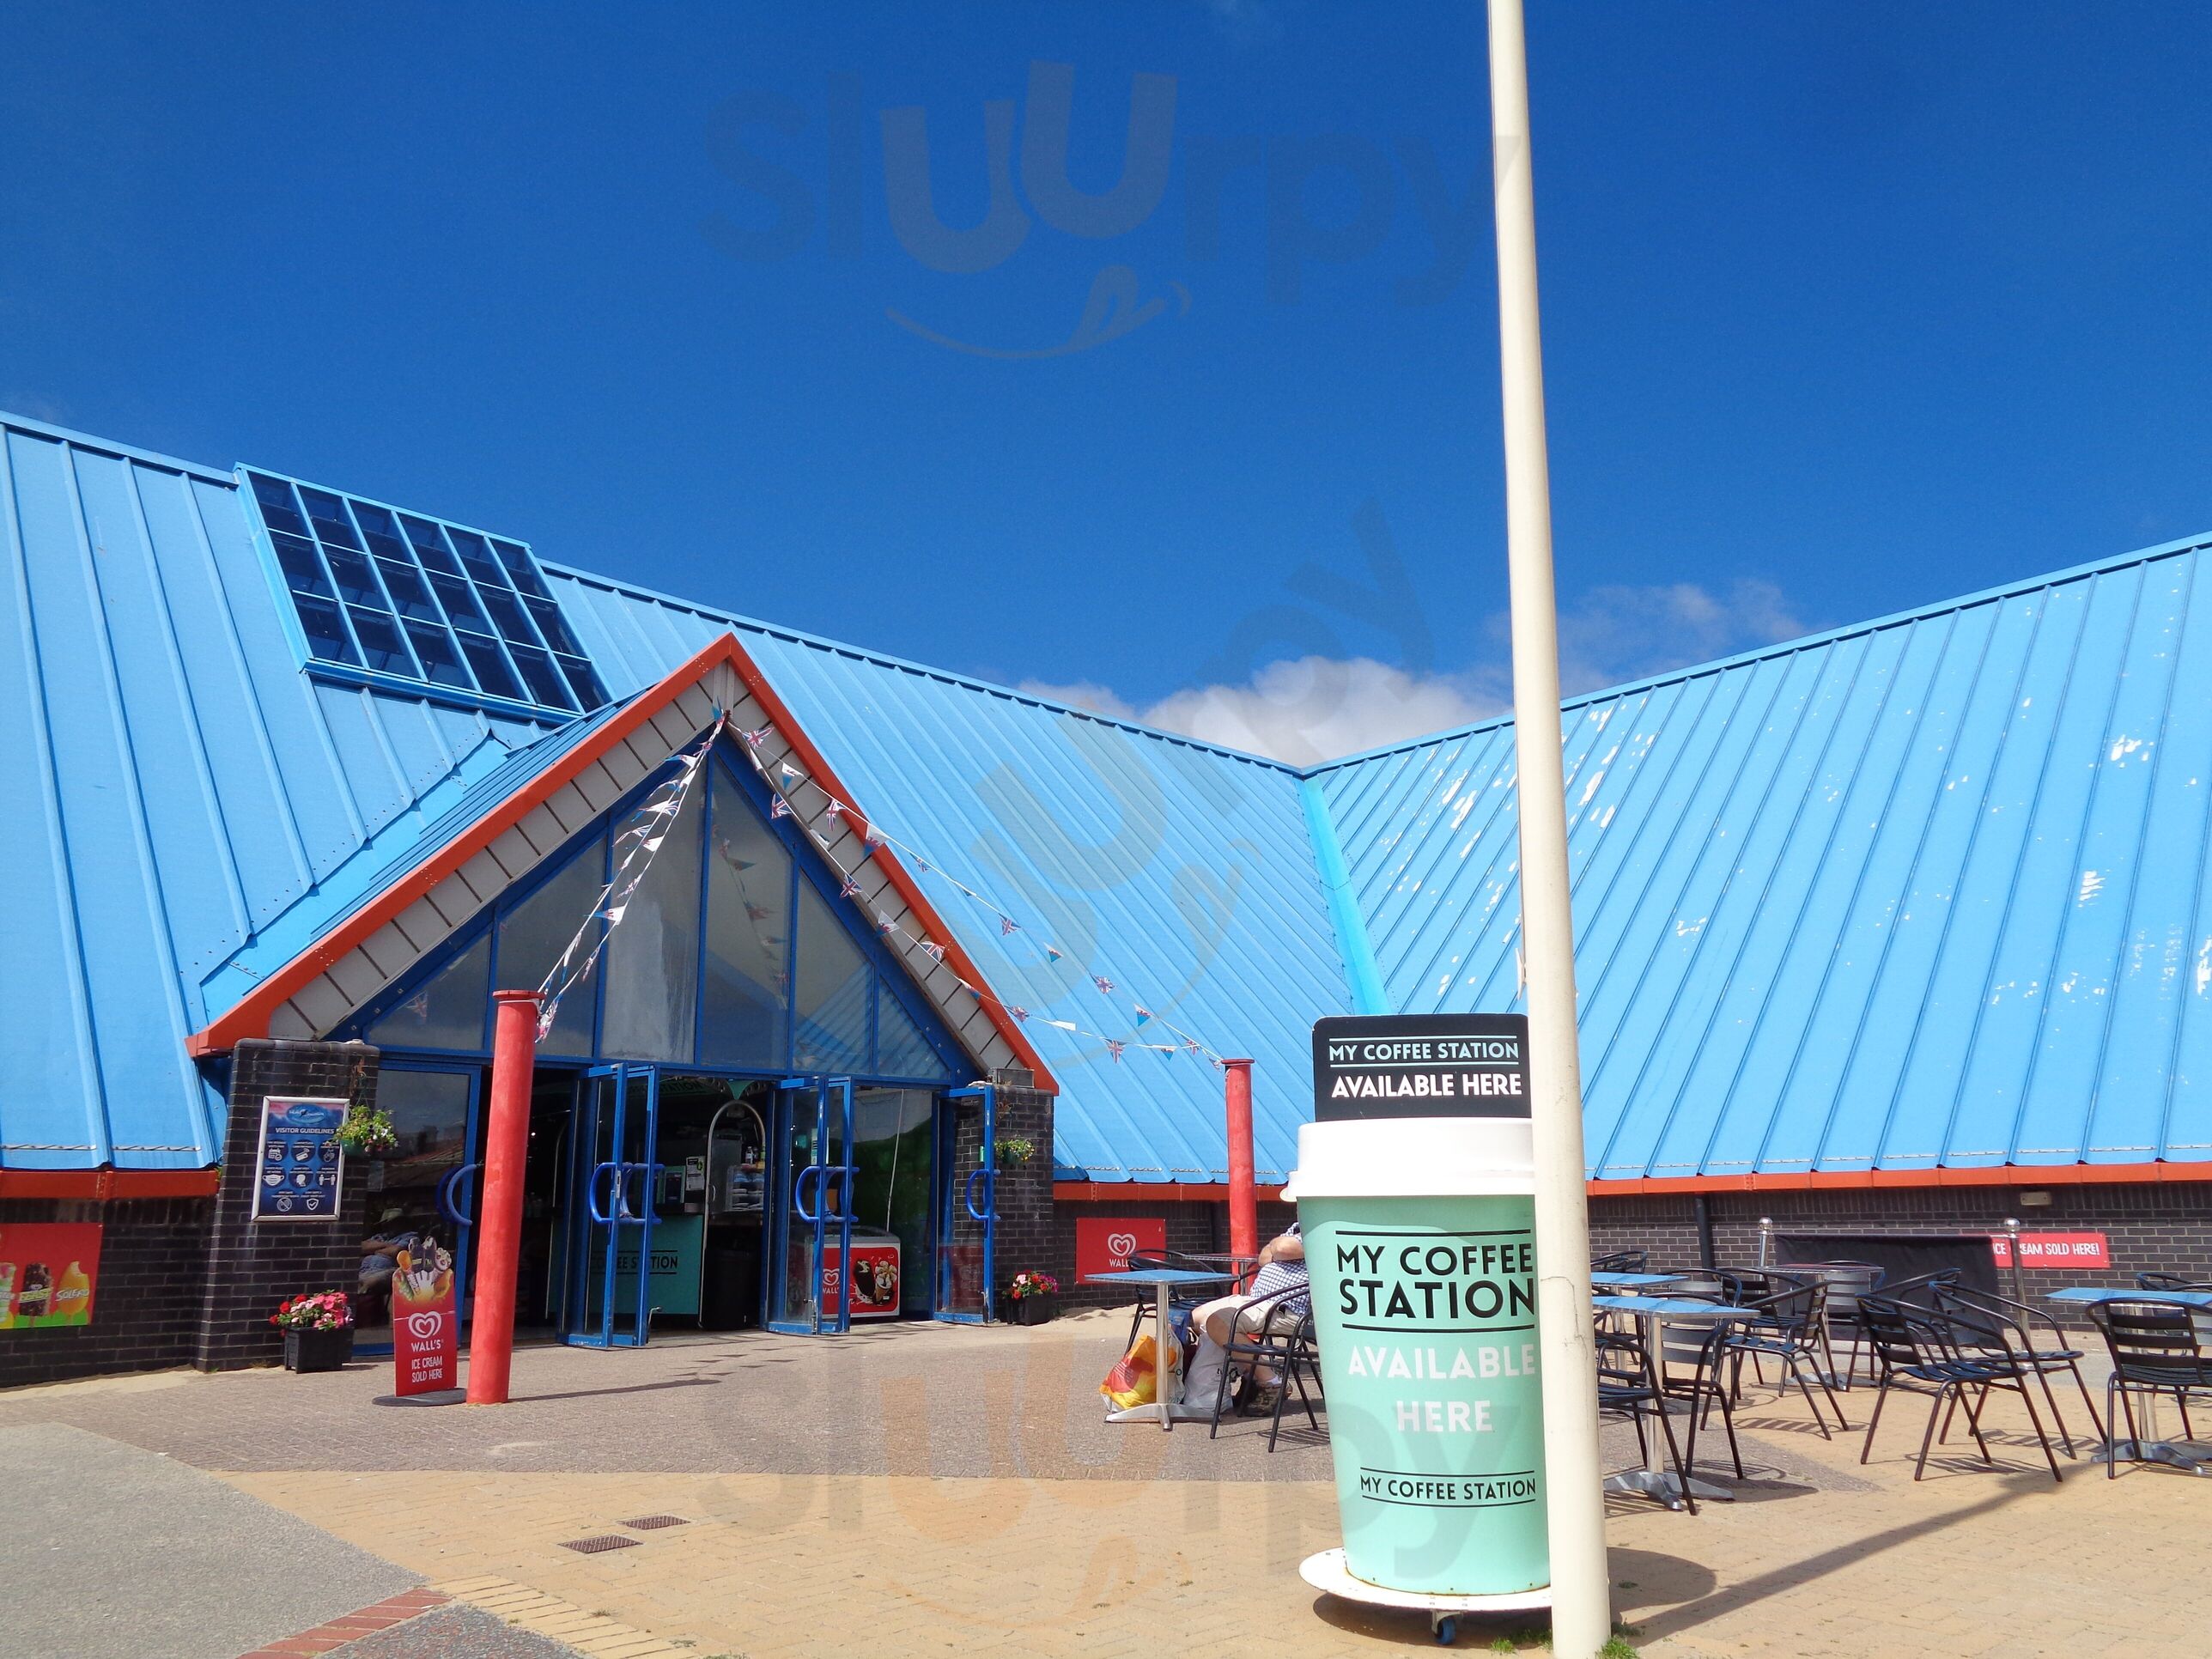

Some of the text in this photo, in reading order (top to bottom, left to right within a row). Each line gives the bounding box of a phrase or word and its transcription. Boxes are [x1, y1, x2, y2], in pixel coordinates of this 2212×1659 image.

[1329, 1042, 1519, 1061] MY COFFEE STATION
[1331, 1073, 1522, 1098] AVAILABLE HERE
[1337, 1243, 1534, 1276] MY COFFEE
[1992, 1243, 2007, 1255] ICE
[2045, 1243, 2069, 1255] SOLD
[2072, 1243, 2100, 1255] HERE!
[1340, 1277, 1535, 1319] STATION
[411, 1340, 441, 1352] WALL'S
[411, 1356, 442, 1370] ICE CREAM
[1348, 1344, 1536, 1379] AVAILABLE
[412, 1368, 443, 1382] SOLD HERE
[1396, 1401, 1492, 1433] HERE
[1360, 1474, 1536, 1500] MY COFFEE STATION
